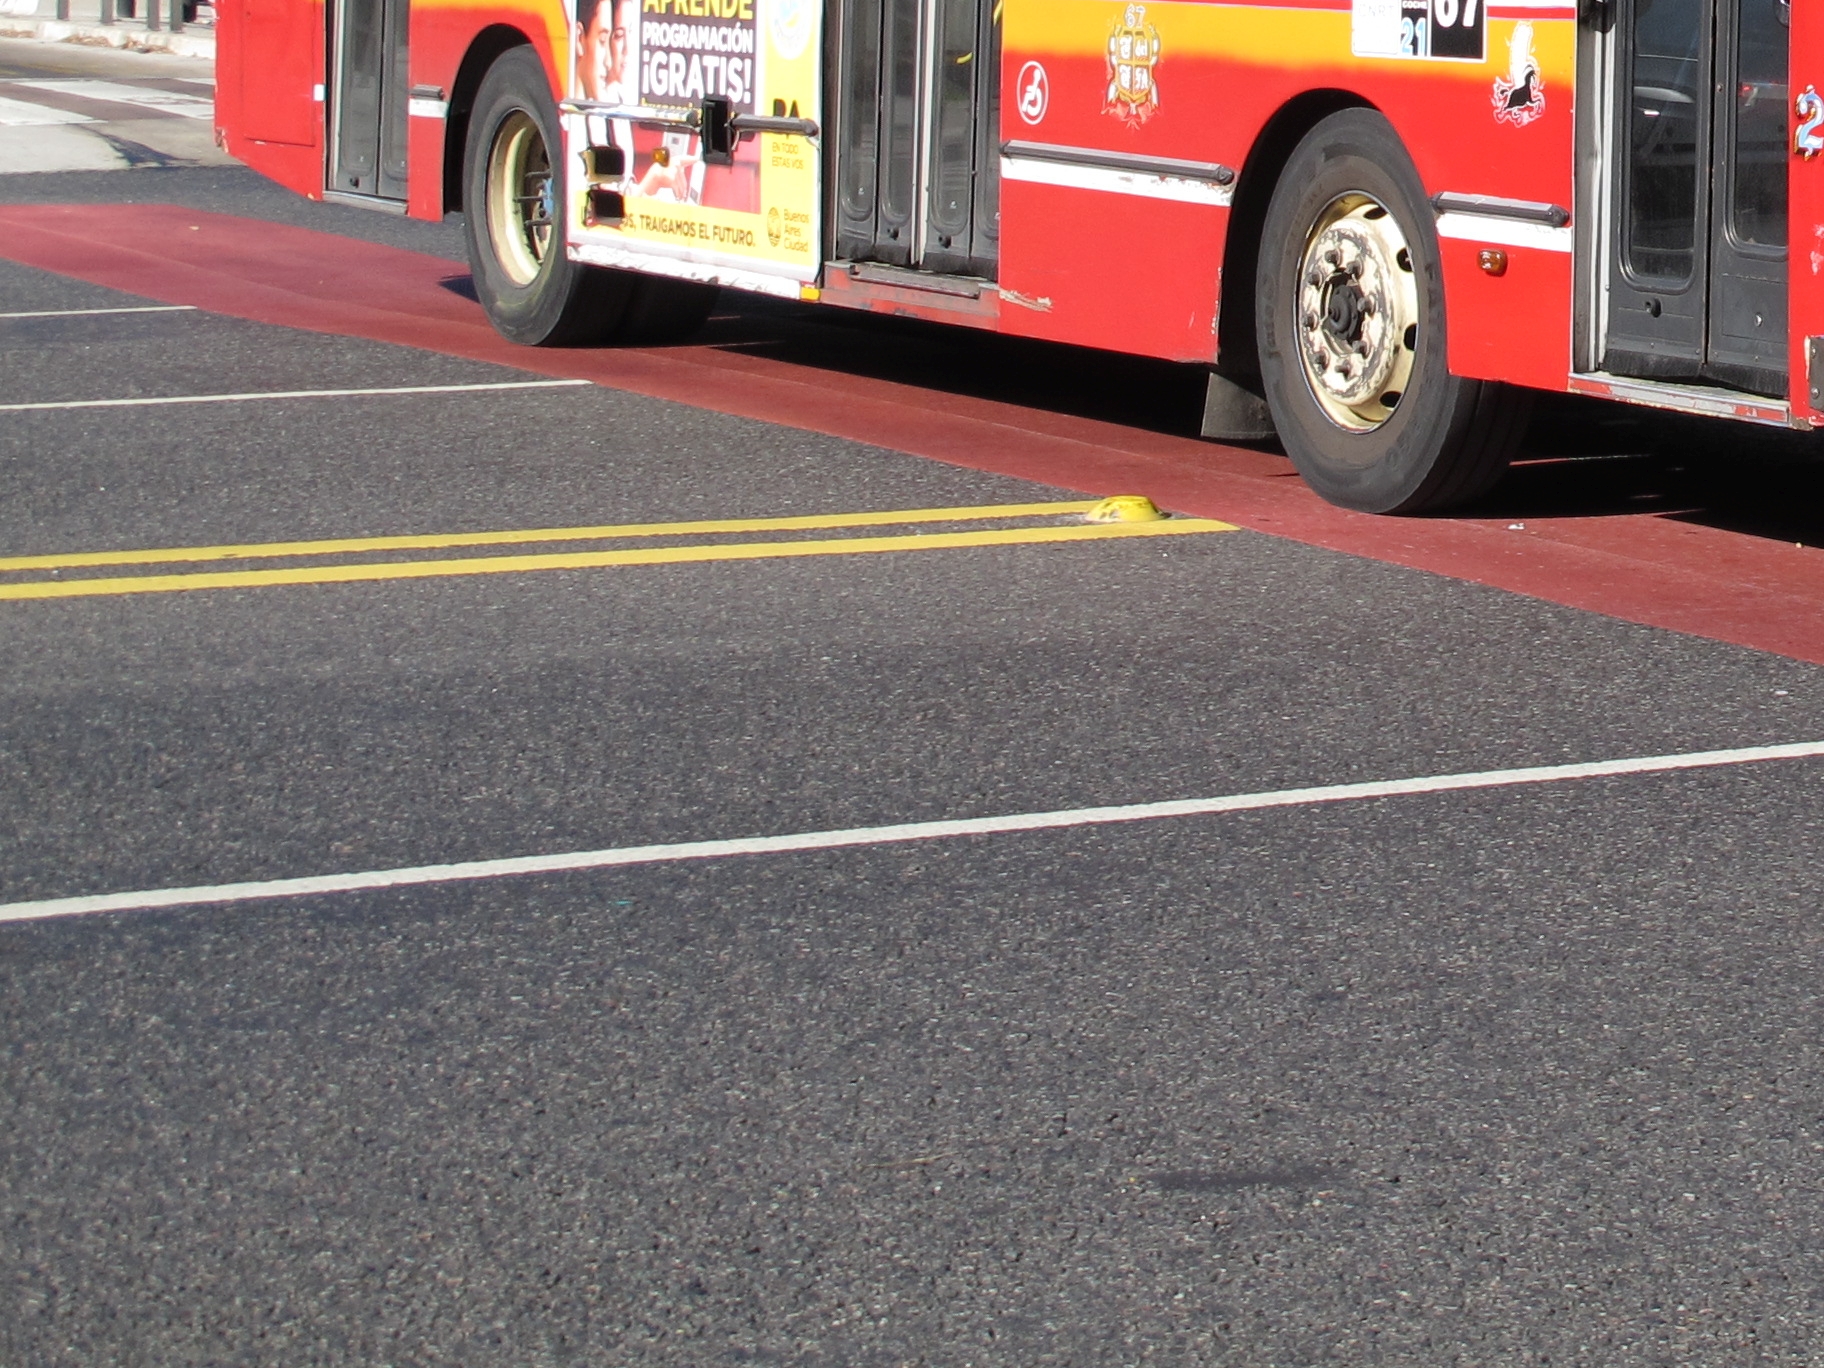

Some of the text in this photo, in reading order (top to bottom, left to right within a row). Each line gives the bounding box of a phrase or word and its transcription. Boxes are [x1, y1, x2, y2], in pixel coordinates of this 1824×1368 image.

[1124, 3, 1147, 29] 67
[642, 21, 754, 54] PROGRAMACIÓN
[1401, 17, 1427, 55] 21
[642, 49, 752, 104] ¡GRATIS!
[639, 214, 697, 238] TRAIGAMOS
[699, 225, 711, 240] EL
[712, 225, 757, 247] FUTURO.
[784, 208, 809, 223] Buenos
